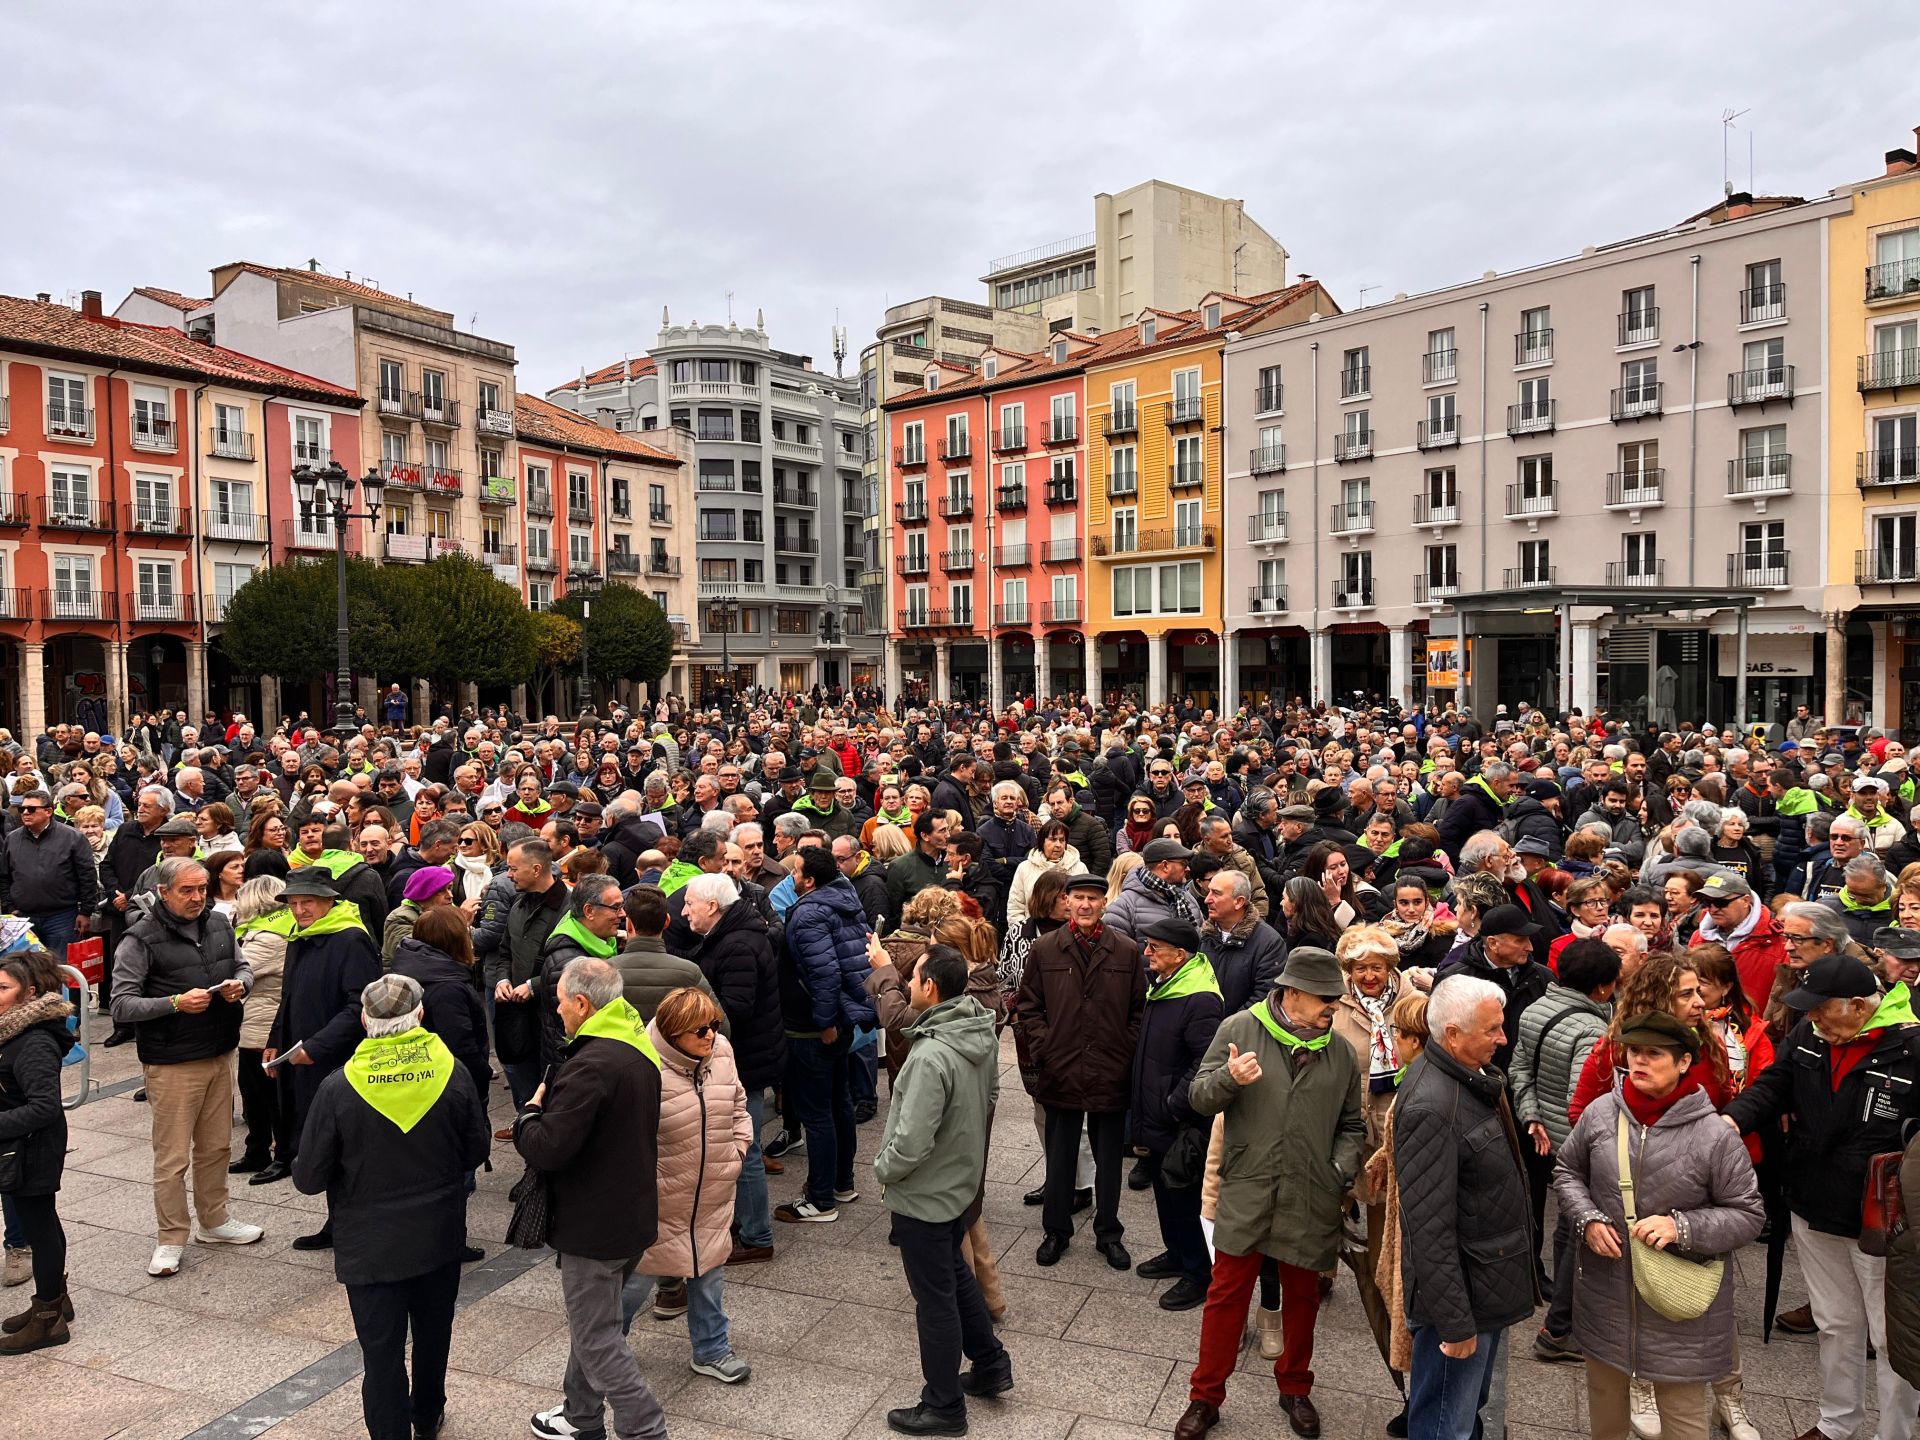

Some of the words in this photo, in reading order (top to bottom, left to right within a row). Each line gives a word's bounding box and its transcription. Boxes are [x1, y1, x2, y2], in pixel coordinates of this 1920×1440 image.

[487, 410, 511, 419] ALQUILER
[488, 416, 511, 425] OFICINAS
[390, 465, 420, 484] AON
[433, 471, 460, 489] AON
[1746, 663, 1774, 672] GAES
[368, 1073, 414, 1084] DIRECTO
[417, 1070, 435, 1082] ¡YA!
